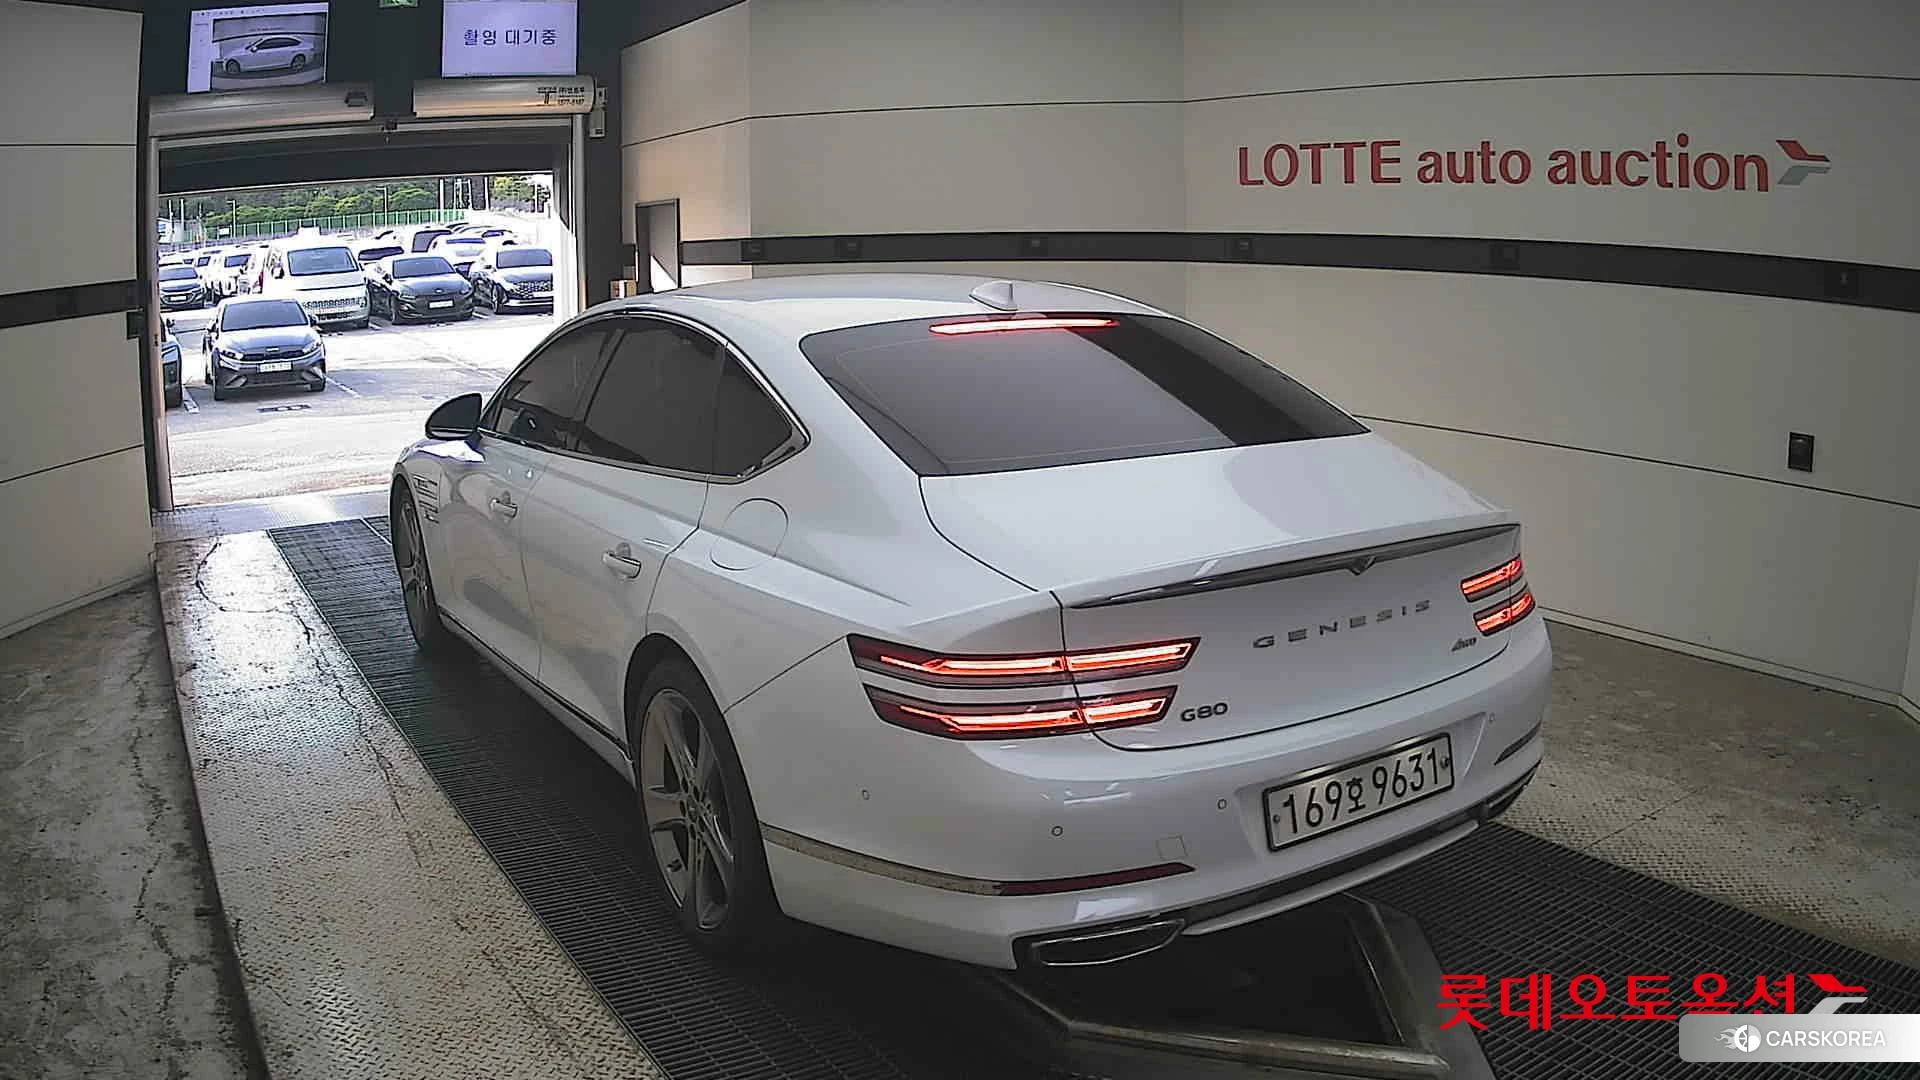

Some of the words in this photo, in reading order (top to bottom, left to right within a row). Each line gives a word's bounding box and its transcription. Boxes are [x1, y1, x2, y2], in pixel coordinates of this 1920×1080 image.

[1239, 140, 1401, 187] LOTTE
[1417, 141, 1532, 184] auto
[1549, 133, 1769, 192] auction
[1253, 600, 1430, 648] GENESIS
[1181, 702, 1228, 722] G80
